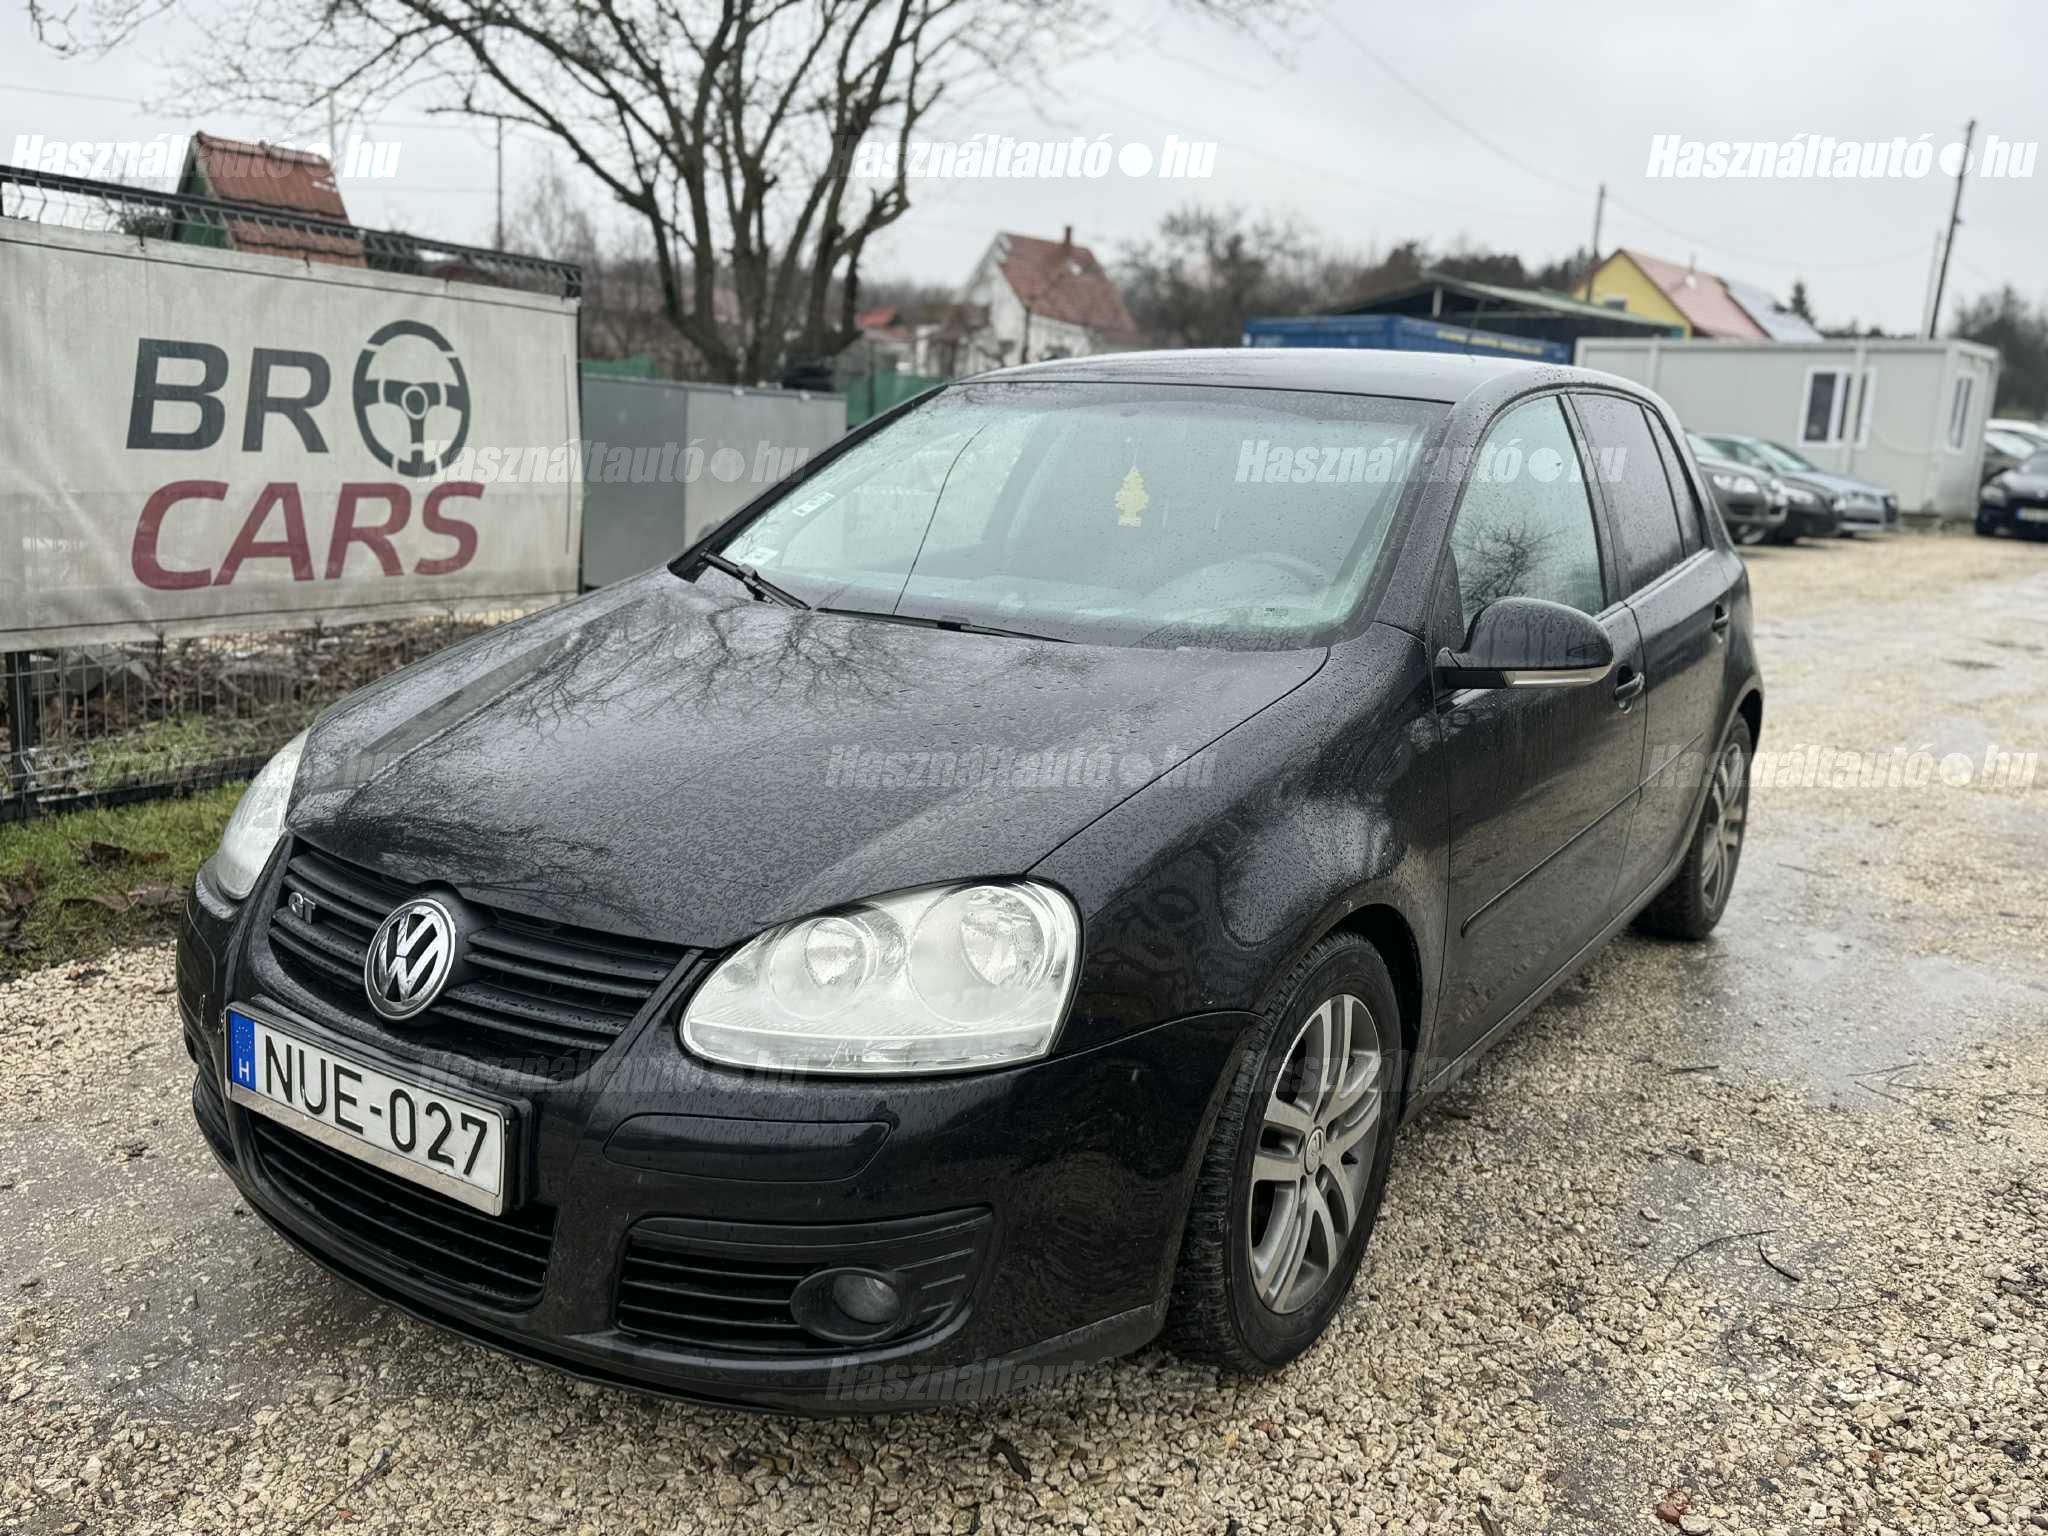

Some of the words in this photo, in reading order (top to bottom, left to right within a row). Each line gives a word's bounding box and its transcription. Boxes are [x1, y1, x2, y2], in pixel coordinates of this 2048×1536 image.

[131, 480, 485, 591] CARS
[288, 892, 316, 924] GT
[238, 1057, 250, 1082] H
[265, 1034, 488, 1176] NUE-027
